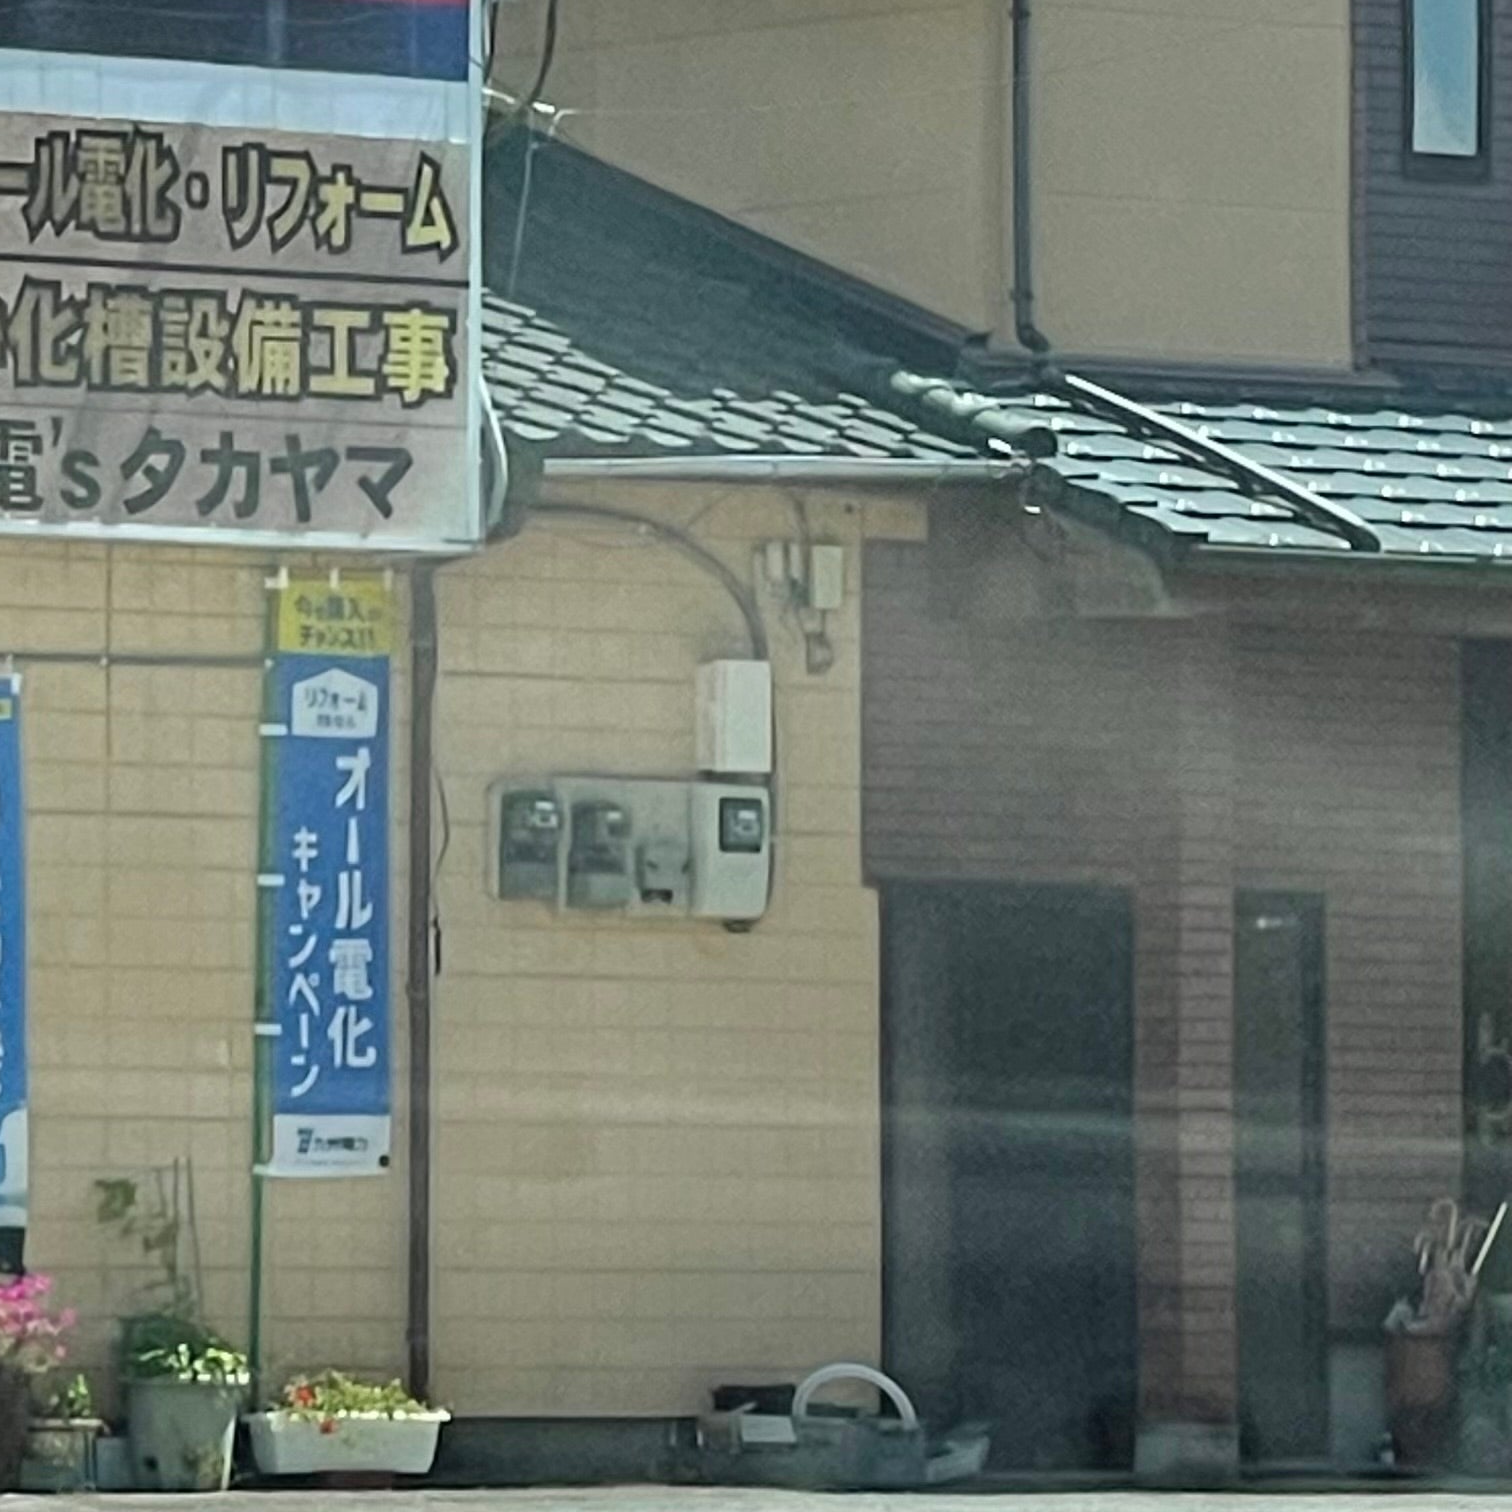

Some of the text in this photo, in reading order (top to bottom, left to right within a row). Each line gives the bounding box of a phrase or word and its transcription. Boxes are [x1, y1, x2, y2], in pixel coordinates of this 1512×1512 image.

[304, 687, 368, 712] リフォーム
[288, 826, 321, 1099] キャンペーン
[327, 747, 377, 1068] オール電化
